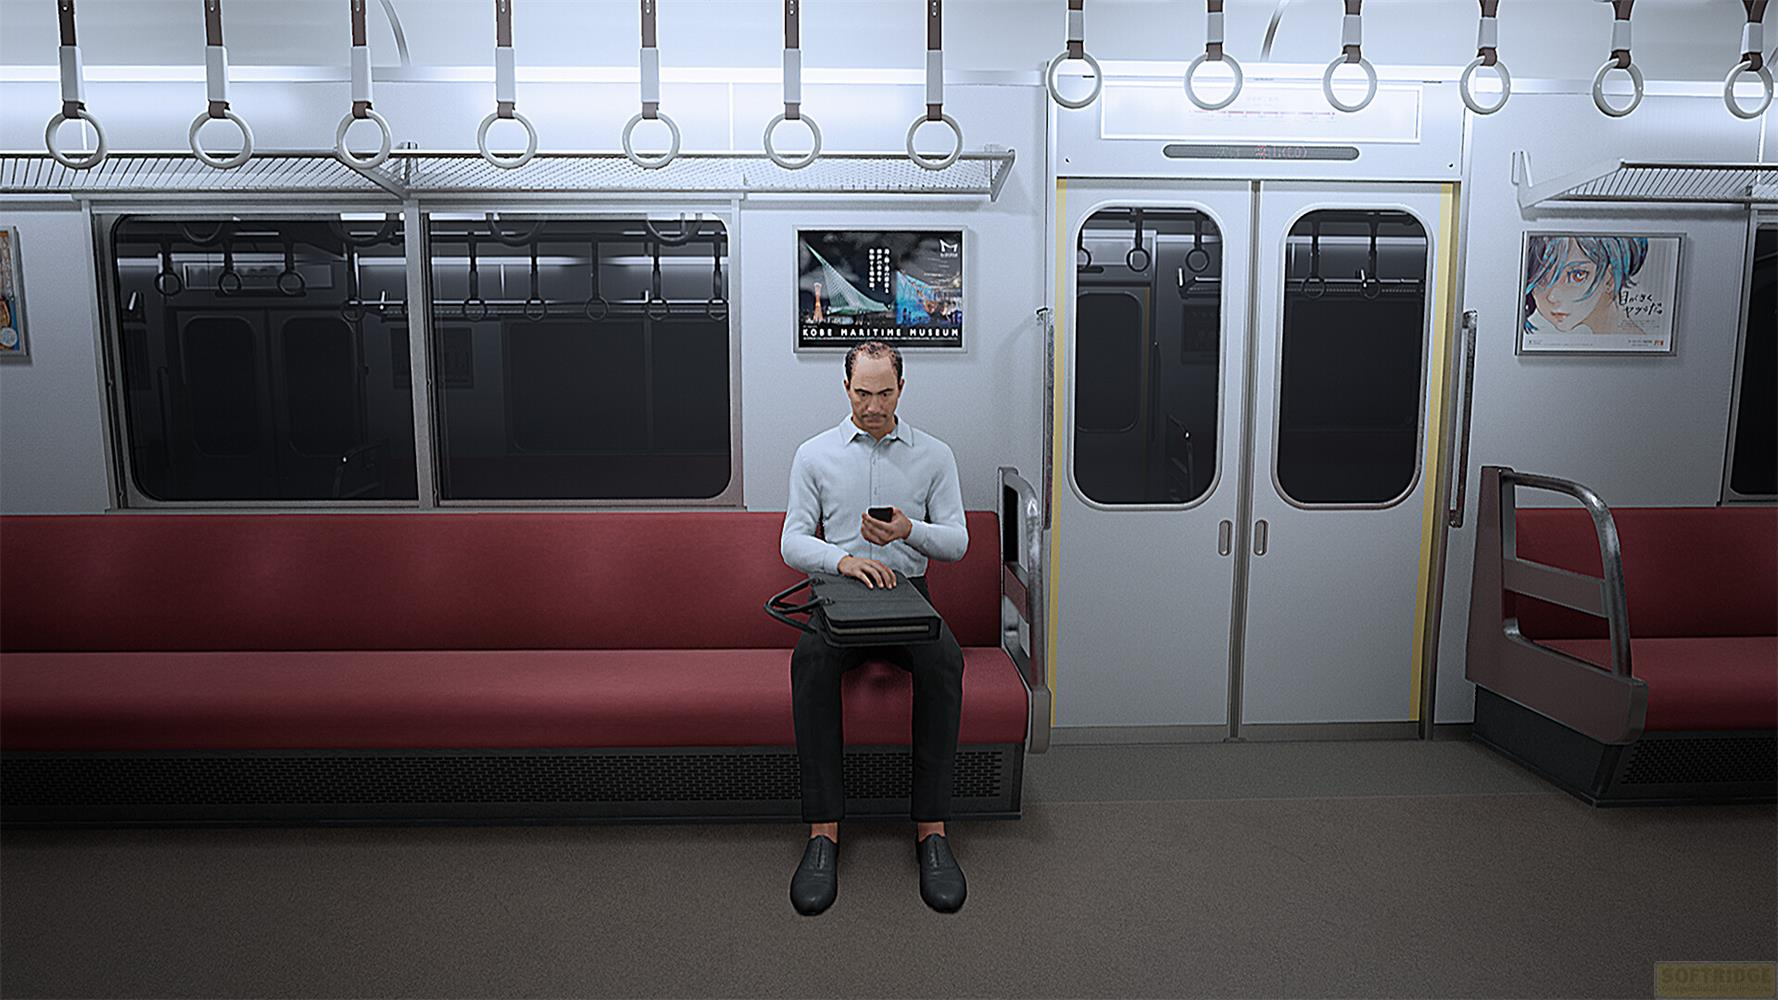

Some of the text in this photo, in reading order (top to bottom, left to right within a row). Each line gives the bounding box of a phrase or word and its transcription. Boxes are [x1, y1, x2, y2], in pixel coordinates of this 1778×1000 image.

[802, 328, 959, 337] KOBE MARITIME MUSEUM
